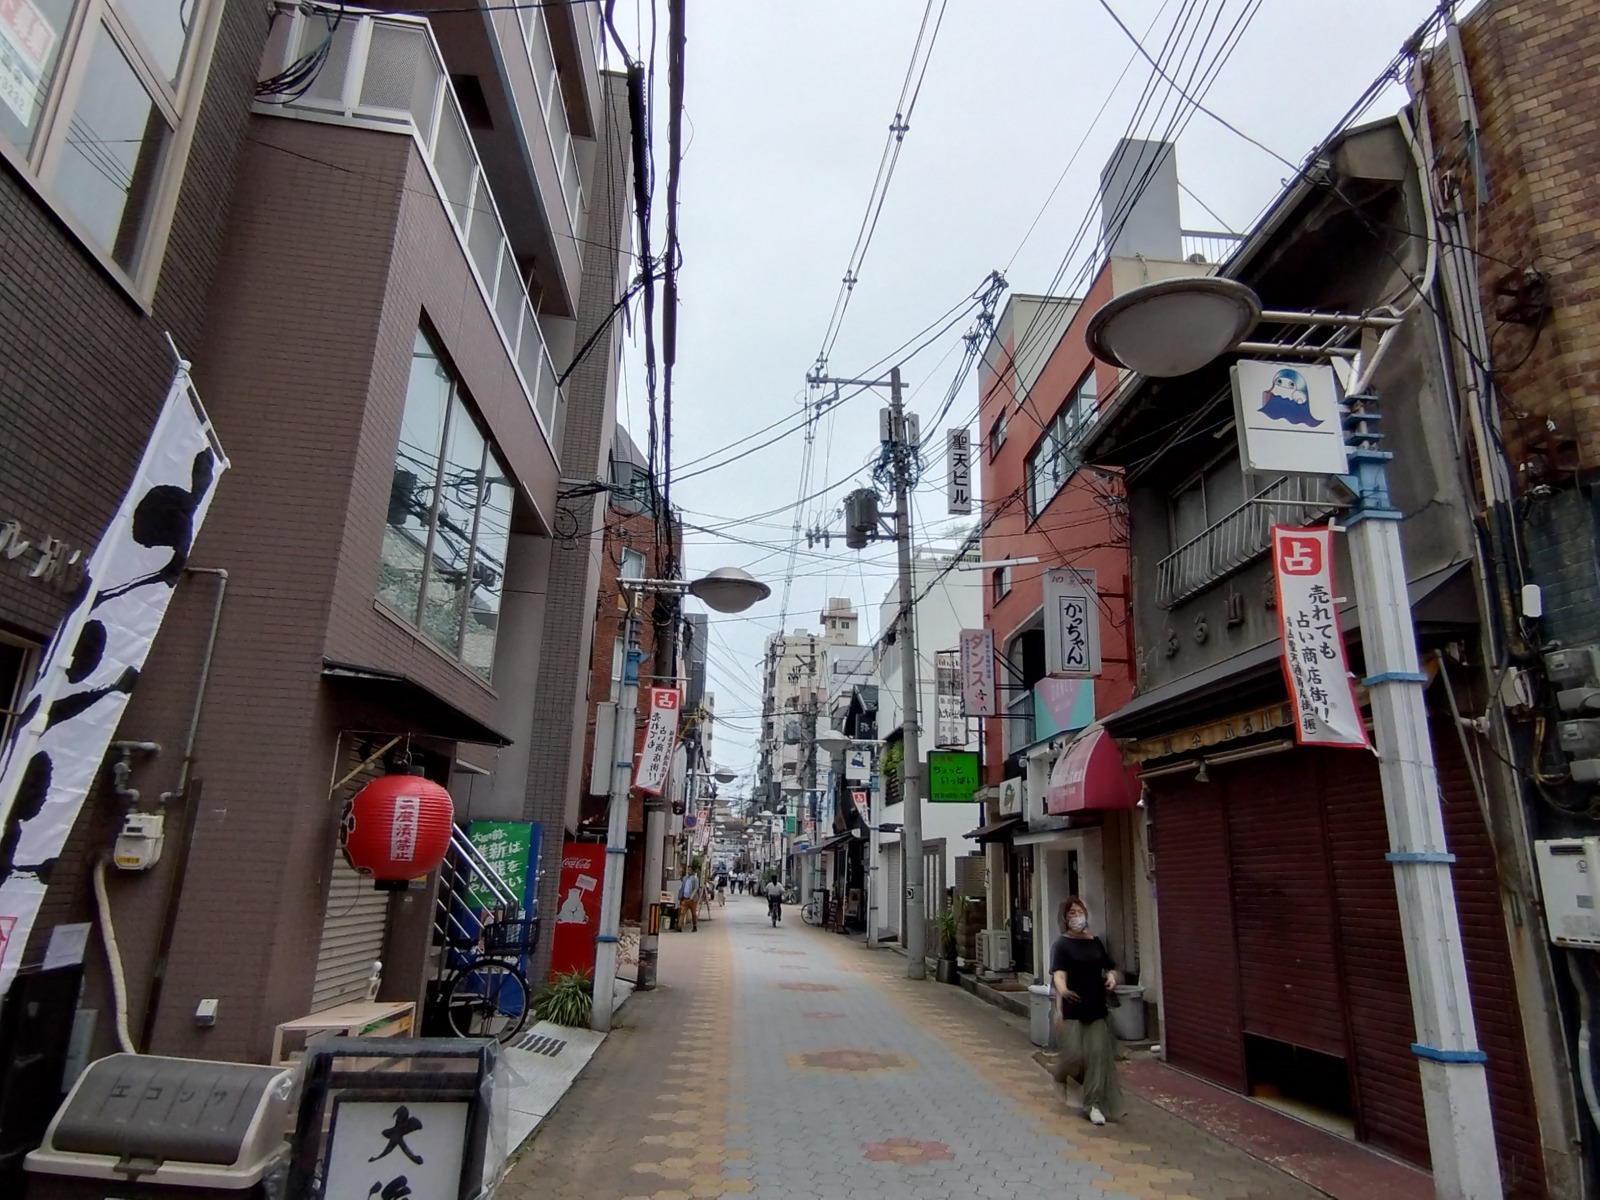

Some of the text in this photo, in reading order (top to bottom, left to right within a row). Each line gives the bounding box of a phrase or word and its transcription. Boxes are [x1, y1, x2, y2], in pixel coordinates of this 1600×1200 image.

[953, 435, 968, 505] 聖天ビル
[1283, 541, 1313, 571] 占
[1064, 602, 1085, 665] かっちゃん
[1308, 584, 1336, 660] 売れても
[970, 633, 985, 687] ダンス
